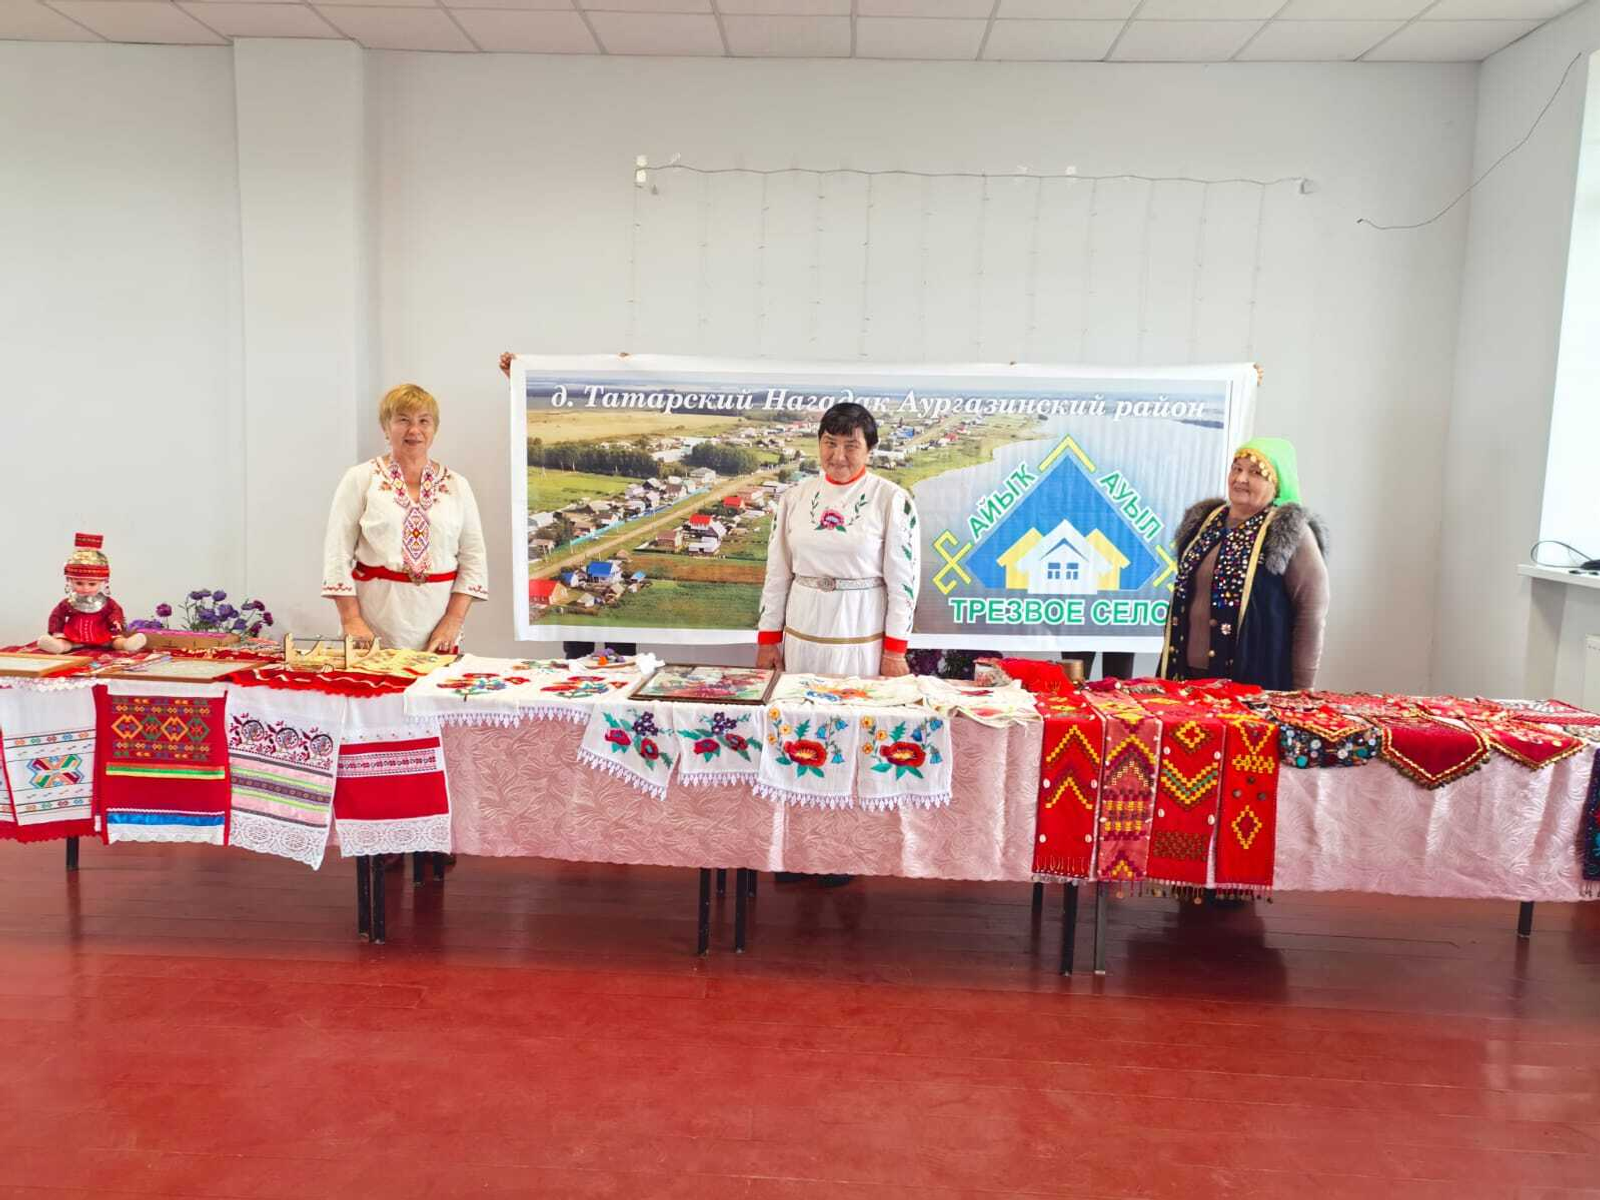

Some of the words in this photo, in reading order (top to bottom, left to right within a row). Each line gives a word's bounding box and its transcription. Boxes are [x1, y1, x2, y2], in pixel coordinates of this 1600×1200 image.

[551, 385, 574, 408] д.
[584, 385, 754, 414] Татарский
[898, 390, 1105, 418] Аургазинский
[1113, 396, 1206, 420] район
[1100, 471, 1163, 540] АУЫЛ
[950, 598, 1084, 624] ТРЕЗВОЕ
[1092, 599, 1169, 625] СЕЛО
